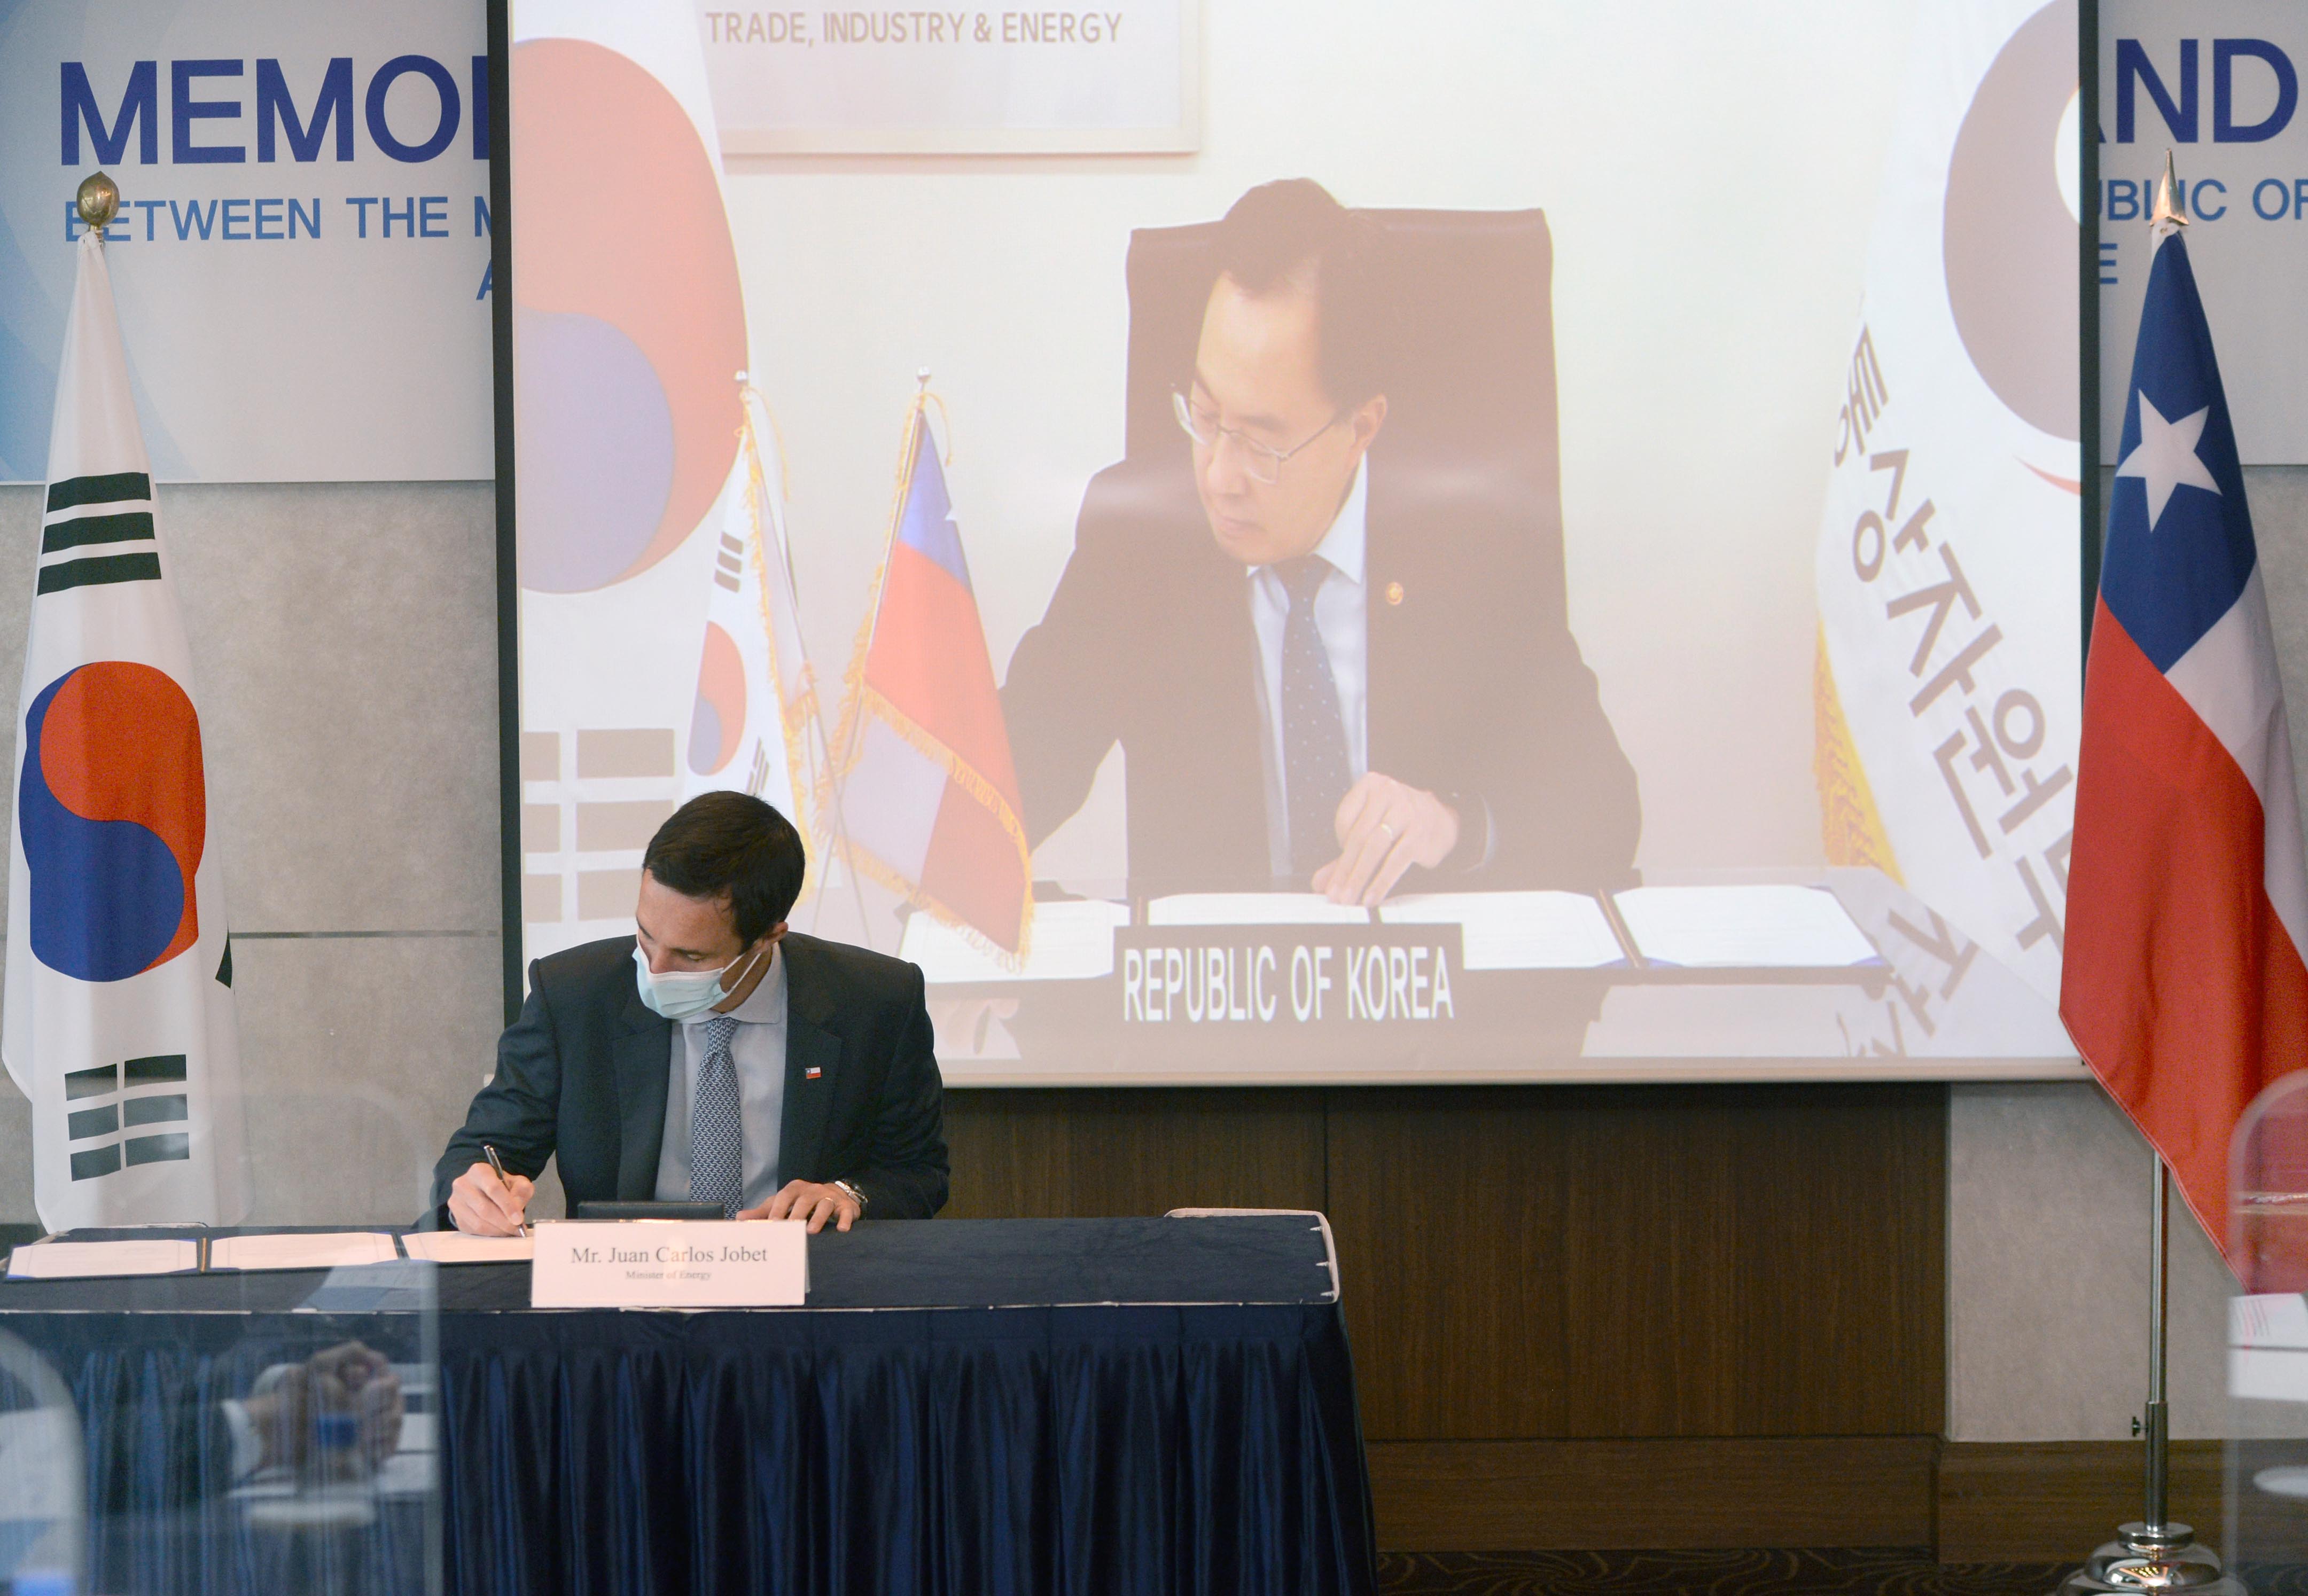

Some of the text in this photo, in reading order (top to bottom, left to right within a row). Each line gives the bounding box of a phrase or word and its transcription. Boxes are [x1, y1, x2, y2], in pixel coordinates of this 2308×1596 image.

[705, 11, 1122, 48] TRADE, INDUSTRY & ENERGY
[61, 54, 488, 166] MEMO
[2099, 39, 2298, 143] ND
[346, 197, 449, 239] THE
[1124, 945, 1454, 1022] REPUBLIC OF KOREA
[571, 1246, 767, 1263] Mr. Juan Carlos Jobet
[626, 1270, 712, 1281] Minister of Energy
